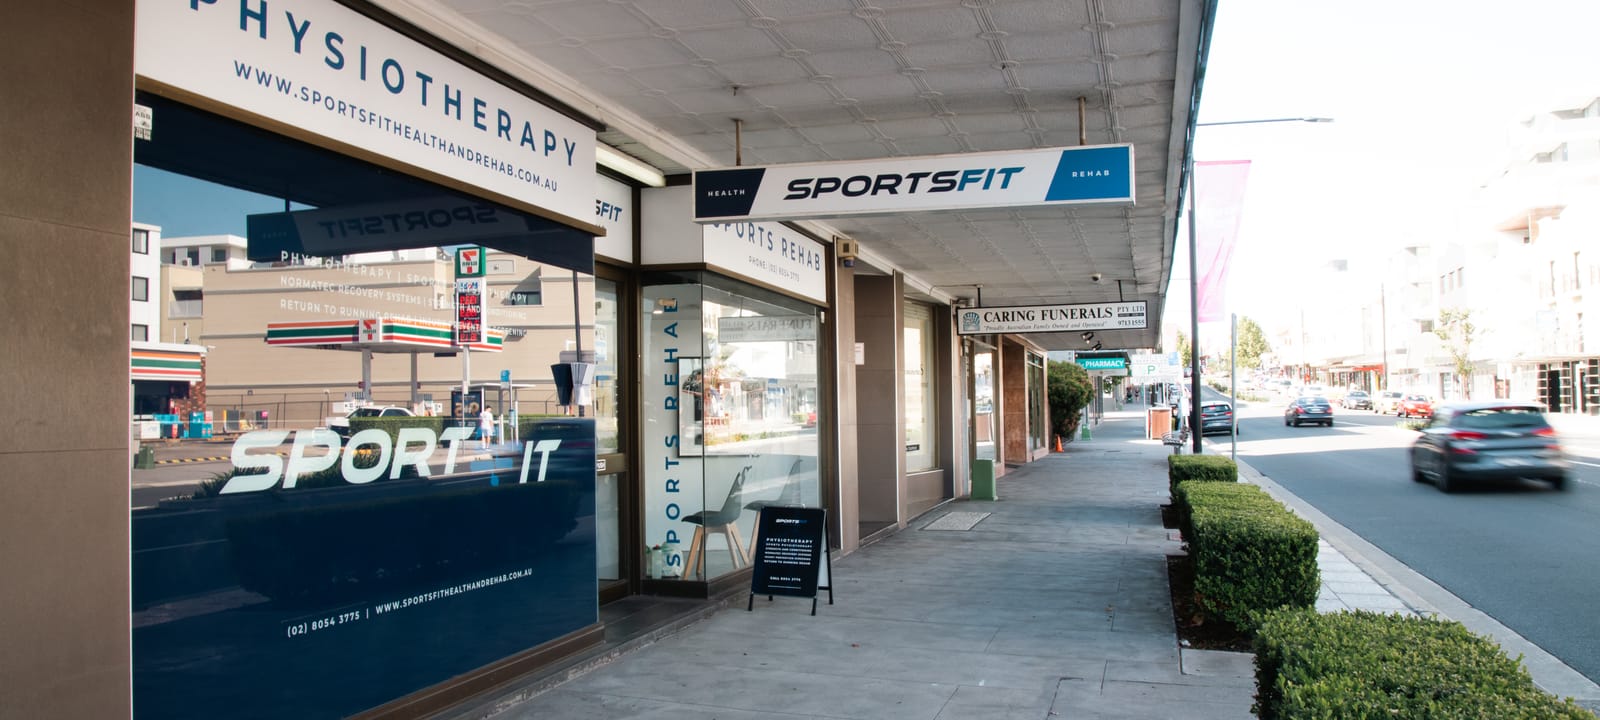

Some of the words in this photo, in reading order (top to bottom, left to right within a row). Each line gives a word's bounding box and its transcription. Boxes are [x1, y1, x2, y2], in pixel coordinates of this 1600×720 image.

[234, 60, 558, 192] WWW.SPORTSFITHEALTHANDREHAB.COM.AU
[1072, 169, 1111, 178] REHAB
[783, 166, 1025, 200] SPORTSFIT
[707, 187, 746, 197] HEALTH
[713, 221, 774, 252] ORTS
[781, 237, 820, 271] REHAB
[338, 285, 384, 299] RECOVERY
[281, 298, 321, 313] RETURN
[324, 304, 337, 315] TO
[983, 309, 1035, 323] CARING
[1041, 307, 1113, 321] FUNERALS
[1085, 360, 1124, 368] PHARMACY
[664, 434, 681, 567] SPORTS
[286, 620, 309, 638] (02)
[311, 616, 336, 631] 8054
[338, 611, 361, 626] 3775
[375, 568, 533, 615] WWW.SPORTSFITHEALTHANDREHAB.COM.AU
